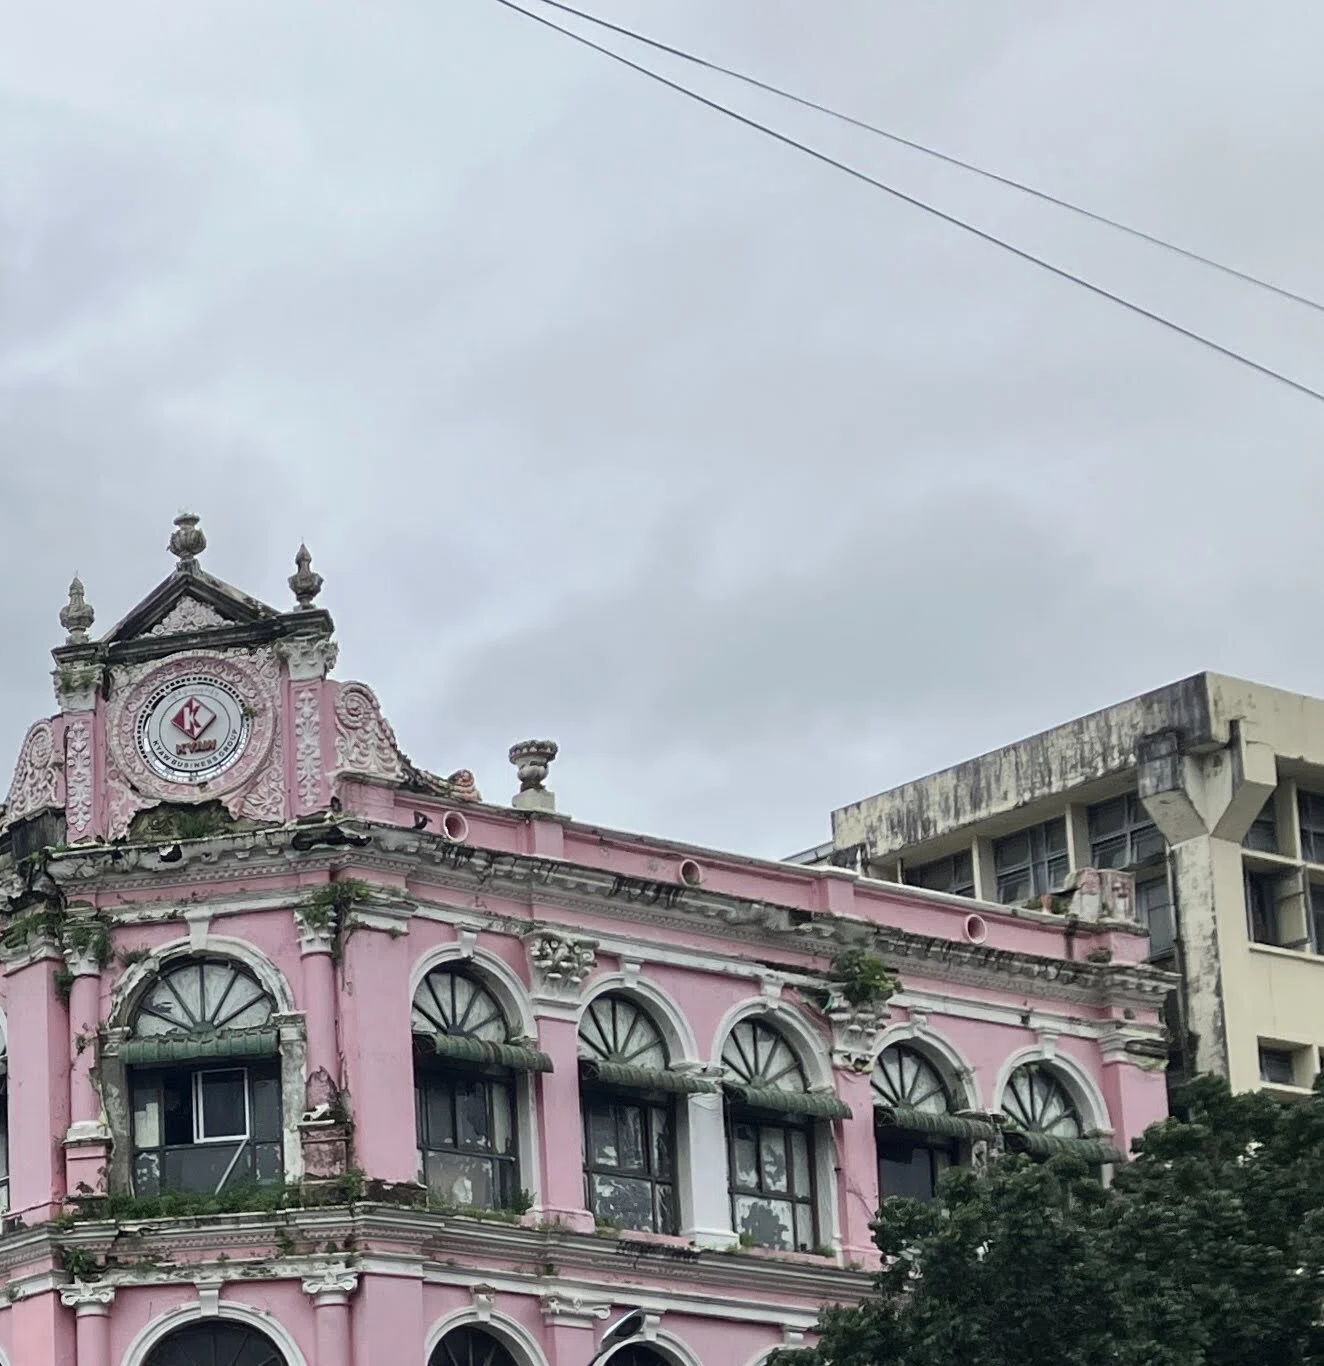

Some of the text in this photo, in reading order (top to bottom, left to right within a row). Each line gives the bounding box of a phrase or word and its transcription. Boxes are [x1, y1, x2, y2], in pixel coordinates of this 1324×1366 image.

[152, 729, 238, 768] KYAW BUSINESS GROUP
